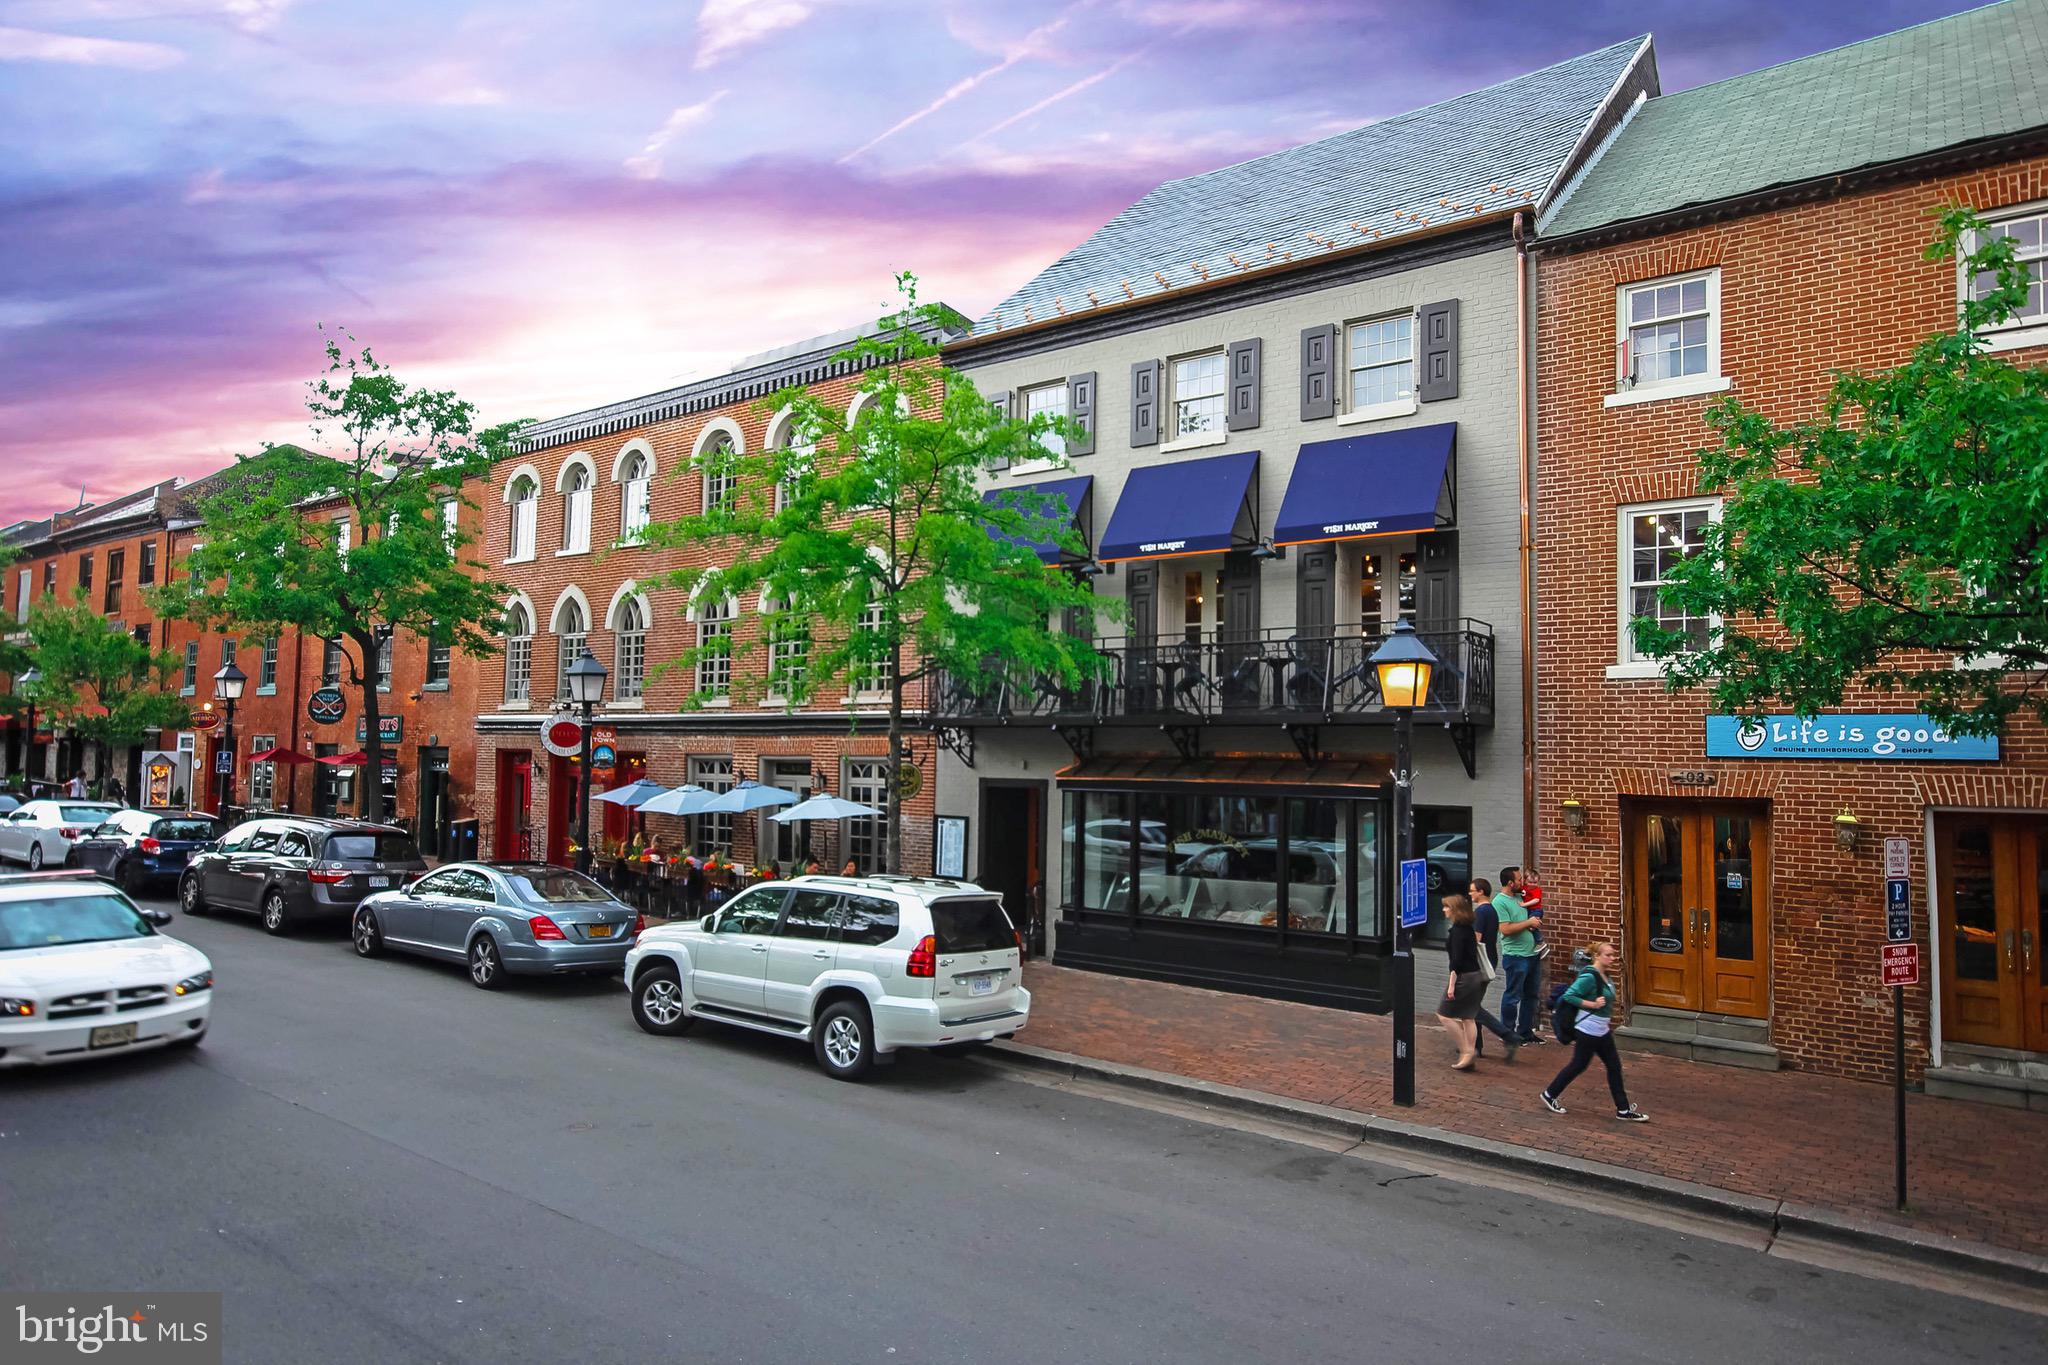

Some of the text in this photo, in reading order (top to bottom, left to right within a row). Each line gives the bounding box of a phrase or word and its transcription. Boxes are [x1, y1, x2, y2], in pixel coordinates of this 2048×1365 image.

[1345, 521, 1379, 533] MARKET
[1158, 540, 1186, 551] MARKET
[1772, 720, 1829, 744] Life
[1838, 724, 1864, 742] is
[1895, 883, 1902, 900] P
[1892, 947, 1908, 956] SNOW
[1884, 956, 1916, 967] EMERGENCY
[1891, 966, 1909, 976] ROUTE
